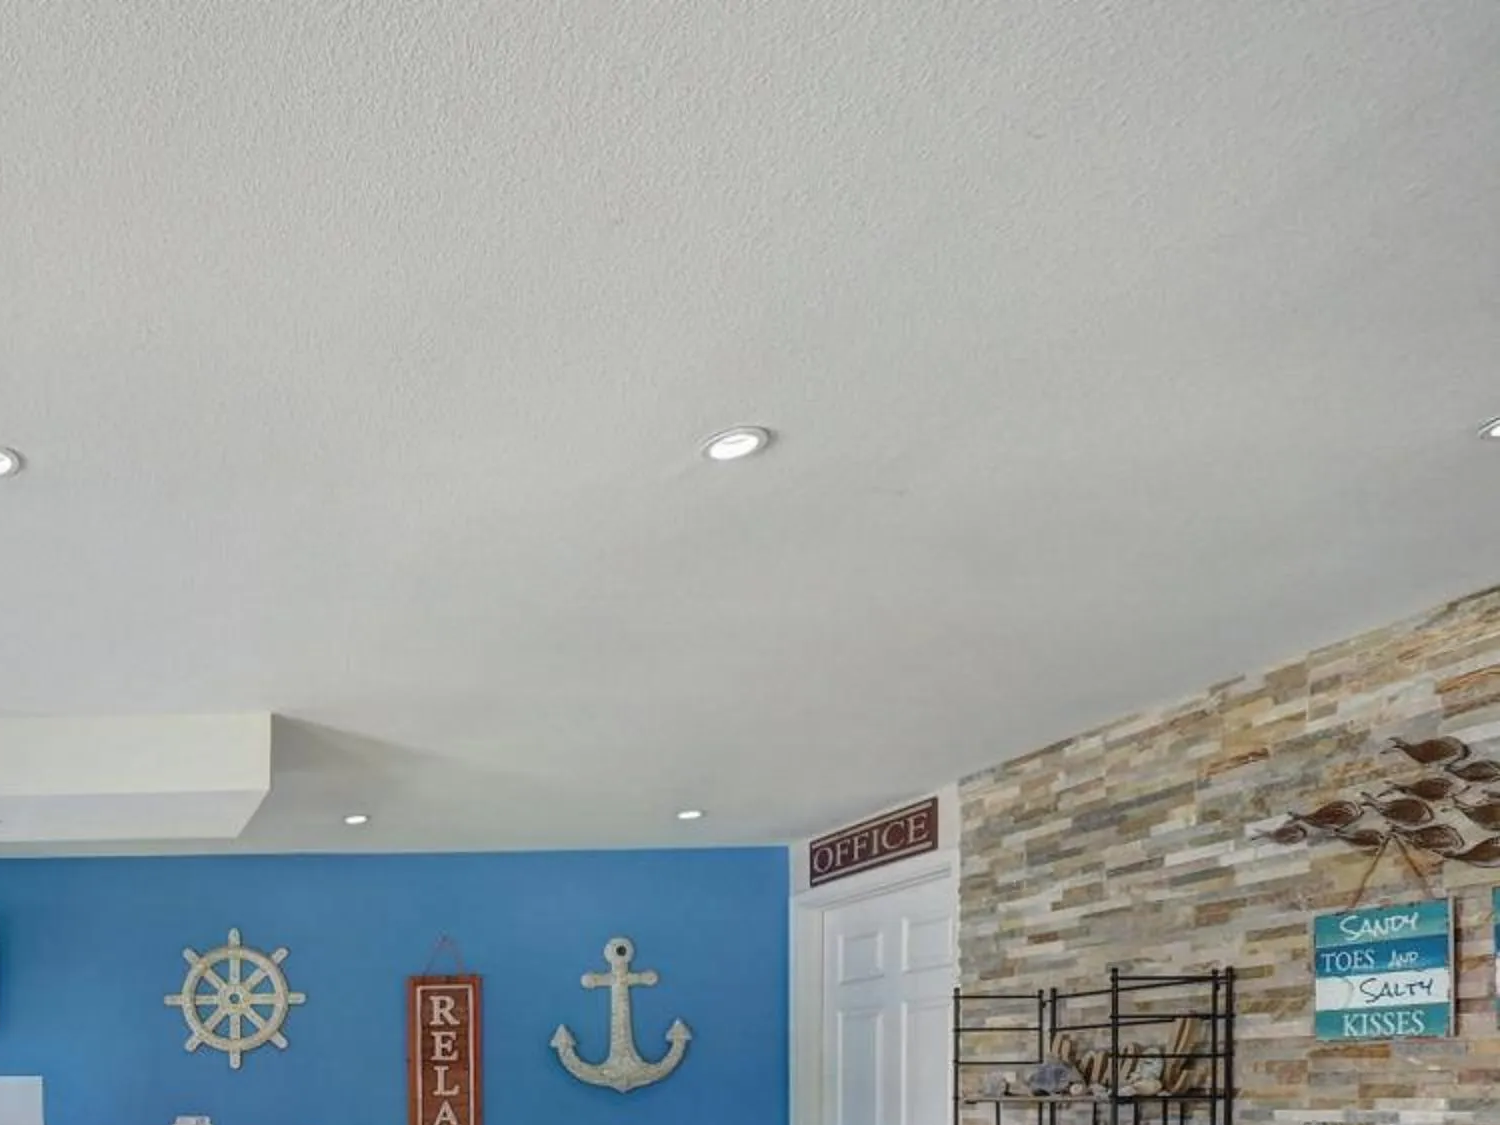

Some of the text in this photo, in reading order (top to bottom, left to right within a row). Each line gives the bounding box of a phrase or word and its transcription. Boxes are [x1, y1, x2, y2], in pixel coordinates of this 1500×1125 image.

[813, 812, 929, 873] OFFICE
[1339, 911, 1419, 942] SANDY
[1320, 949, 1419, 972] TOES AND
[1359, 977, 1433, 1003] SALTY
[1343, 1010, 1426, 1037] KISSES
